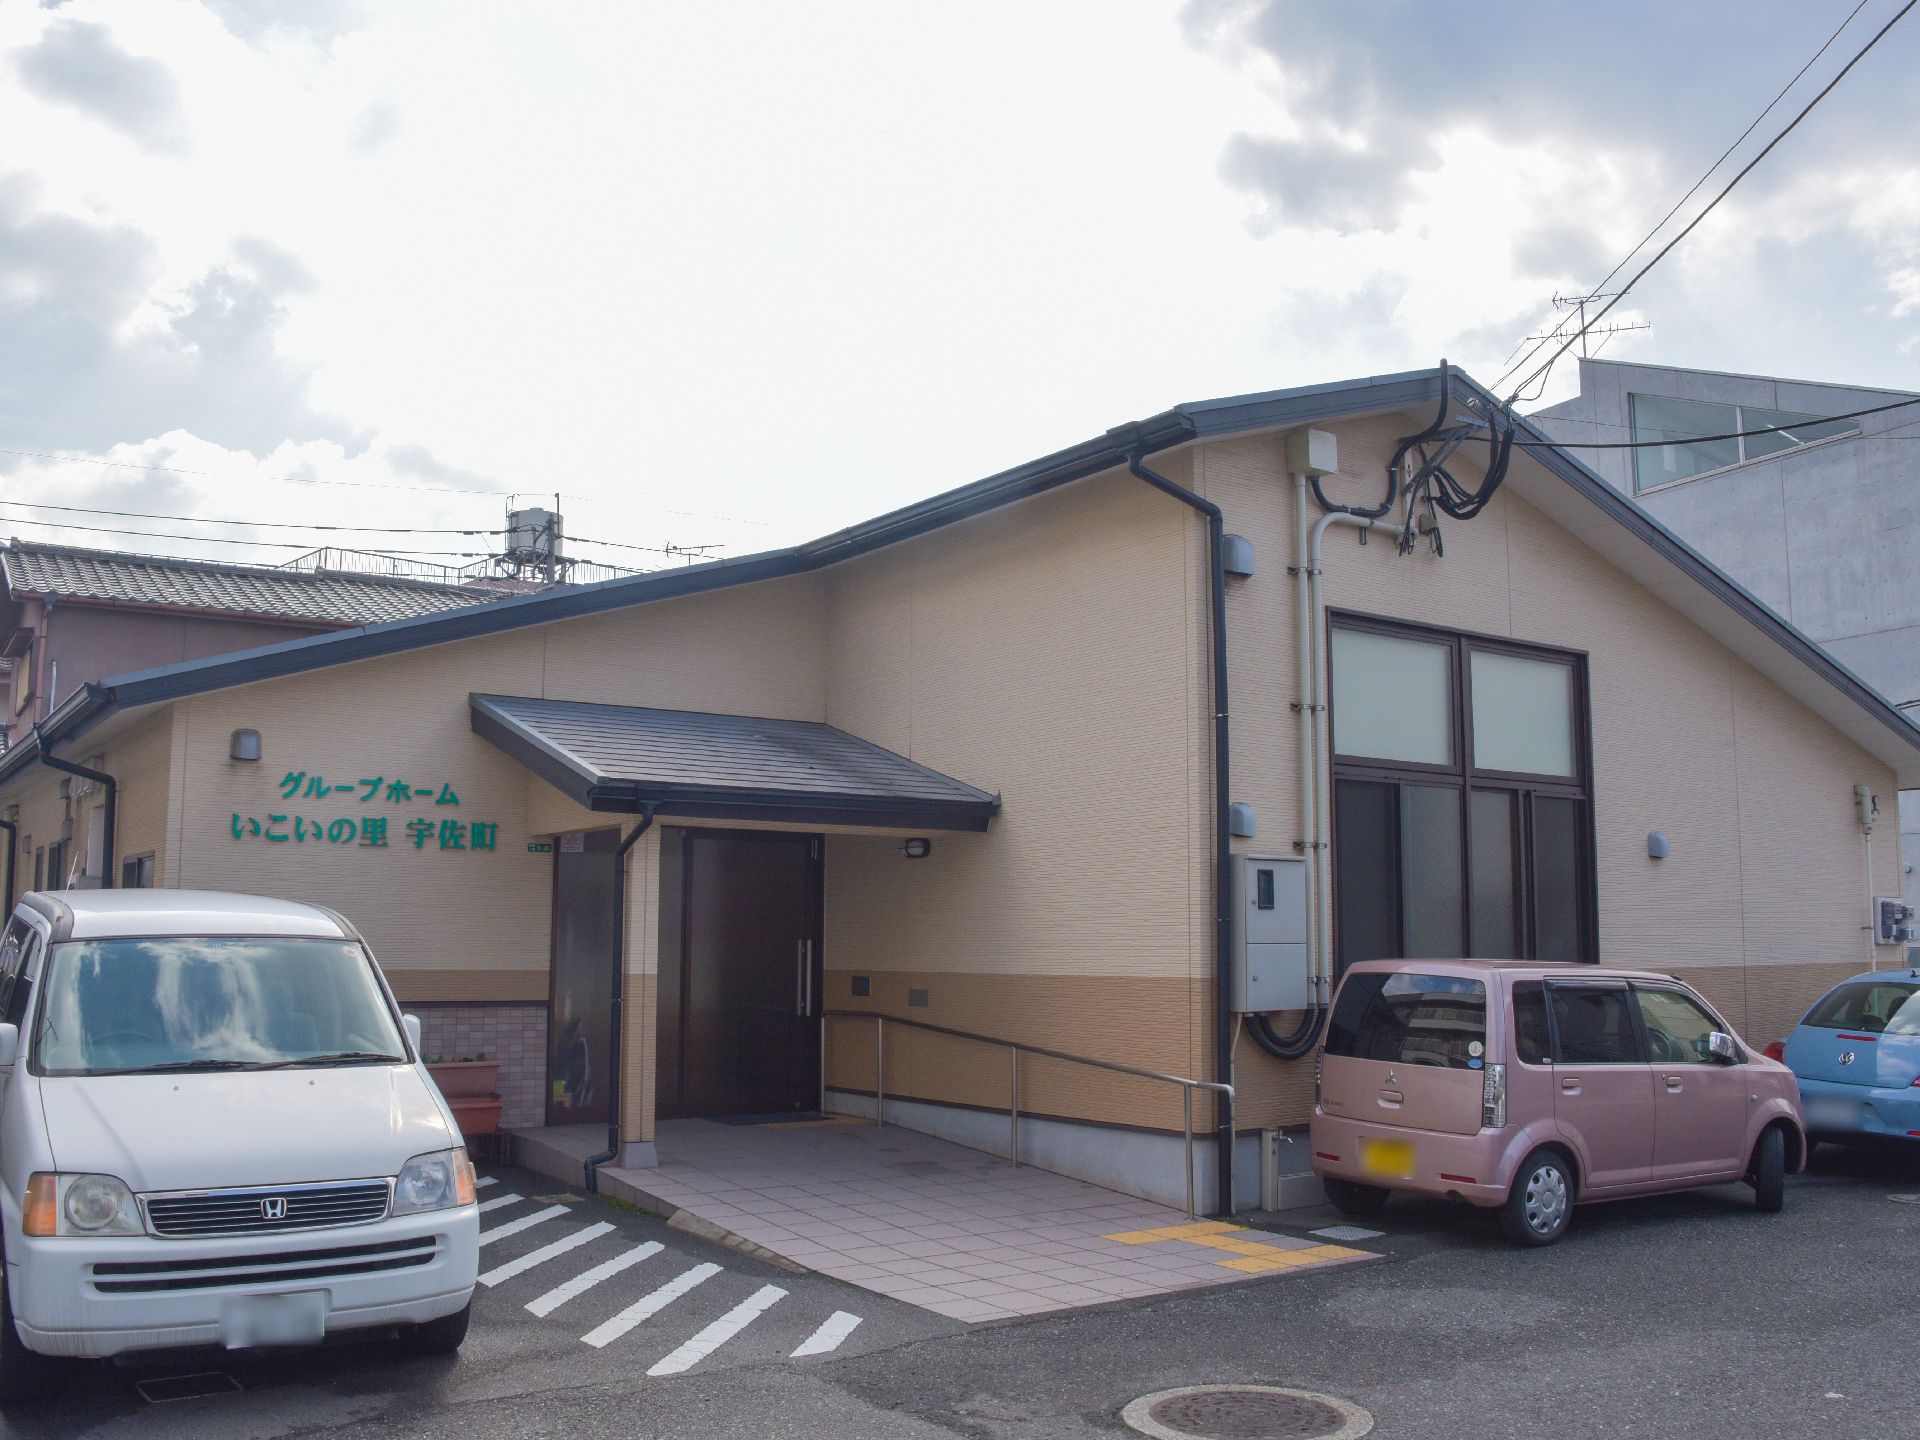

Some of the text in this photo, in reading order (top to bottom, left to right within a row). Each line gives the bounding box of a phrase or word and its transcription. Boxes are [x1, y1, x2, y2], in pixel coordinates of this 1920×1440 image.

[279, 771, 460, 805] グループホーム
[231, 812, 498, 850] いこいの里 宇佐町
